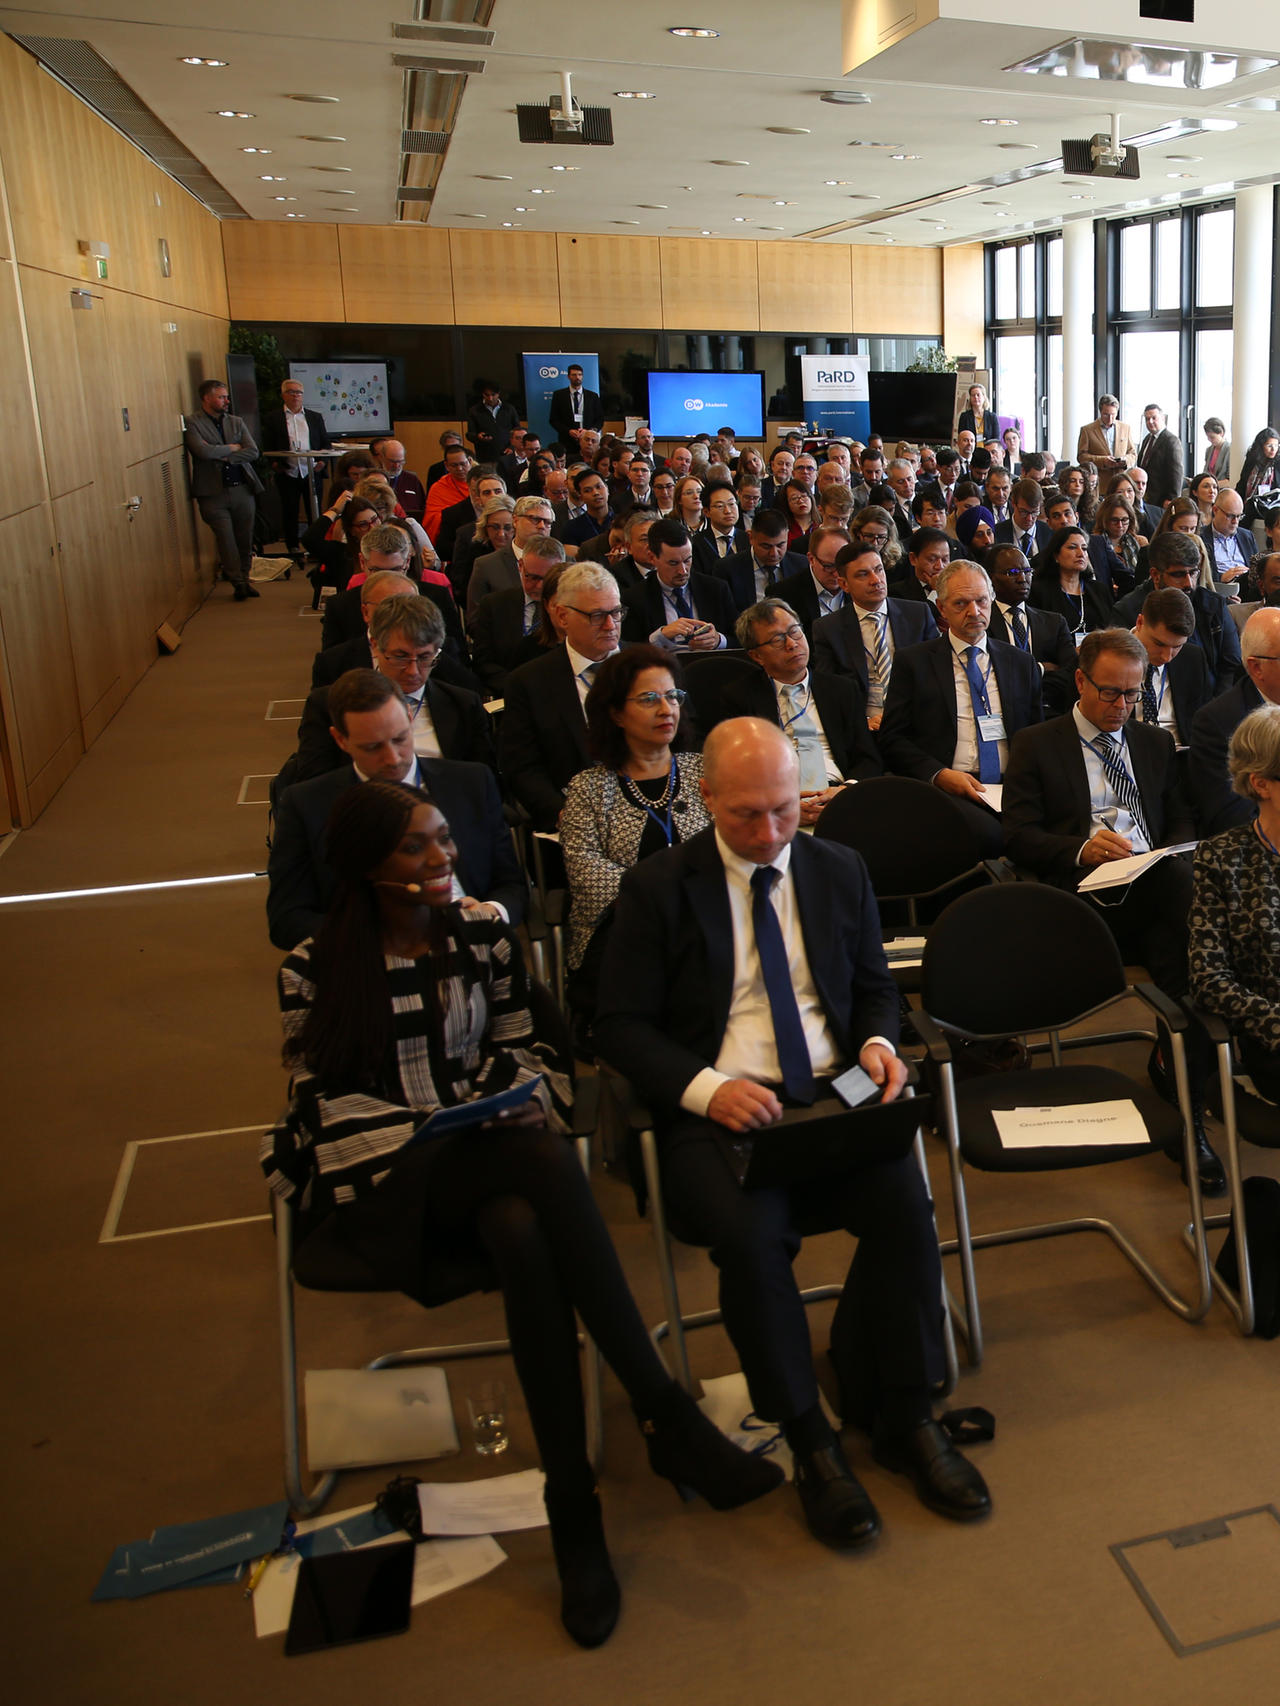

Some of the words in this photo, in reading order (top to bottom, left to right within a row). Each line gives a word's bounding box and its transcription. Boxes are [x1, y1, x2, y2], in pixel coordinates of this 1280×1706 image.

[540, 367, 558, 378] DW
[817, 370, 855, 383] PaRD
[685, 399, 703, 410] DW
